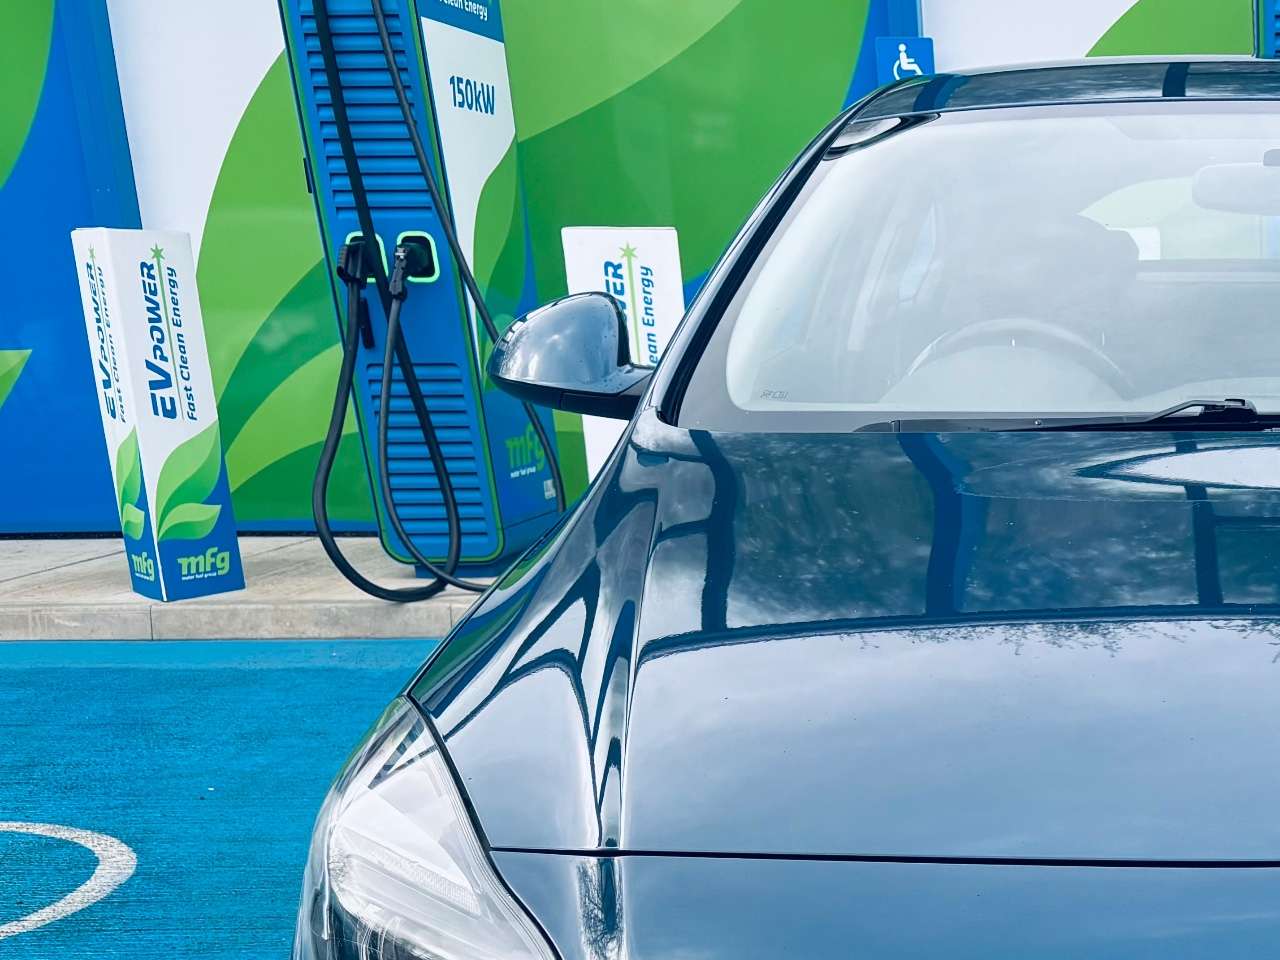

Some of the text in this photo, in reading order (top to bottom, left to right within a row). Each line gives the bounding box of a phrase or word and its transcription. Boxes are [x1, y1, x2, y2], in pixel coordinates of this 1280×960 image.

[449, 75, 495, 115] 150kW
[97, 266, 111, 329] Energy
[640, 265, 658, 365] ean Energy
[108, 333, 120, 383] Clean
[166, 266, 198, 421] Fast Clean Energy
[131, 551, 155, 582] mfg
[177, 546, 230, 576] mfg
